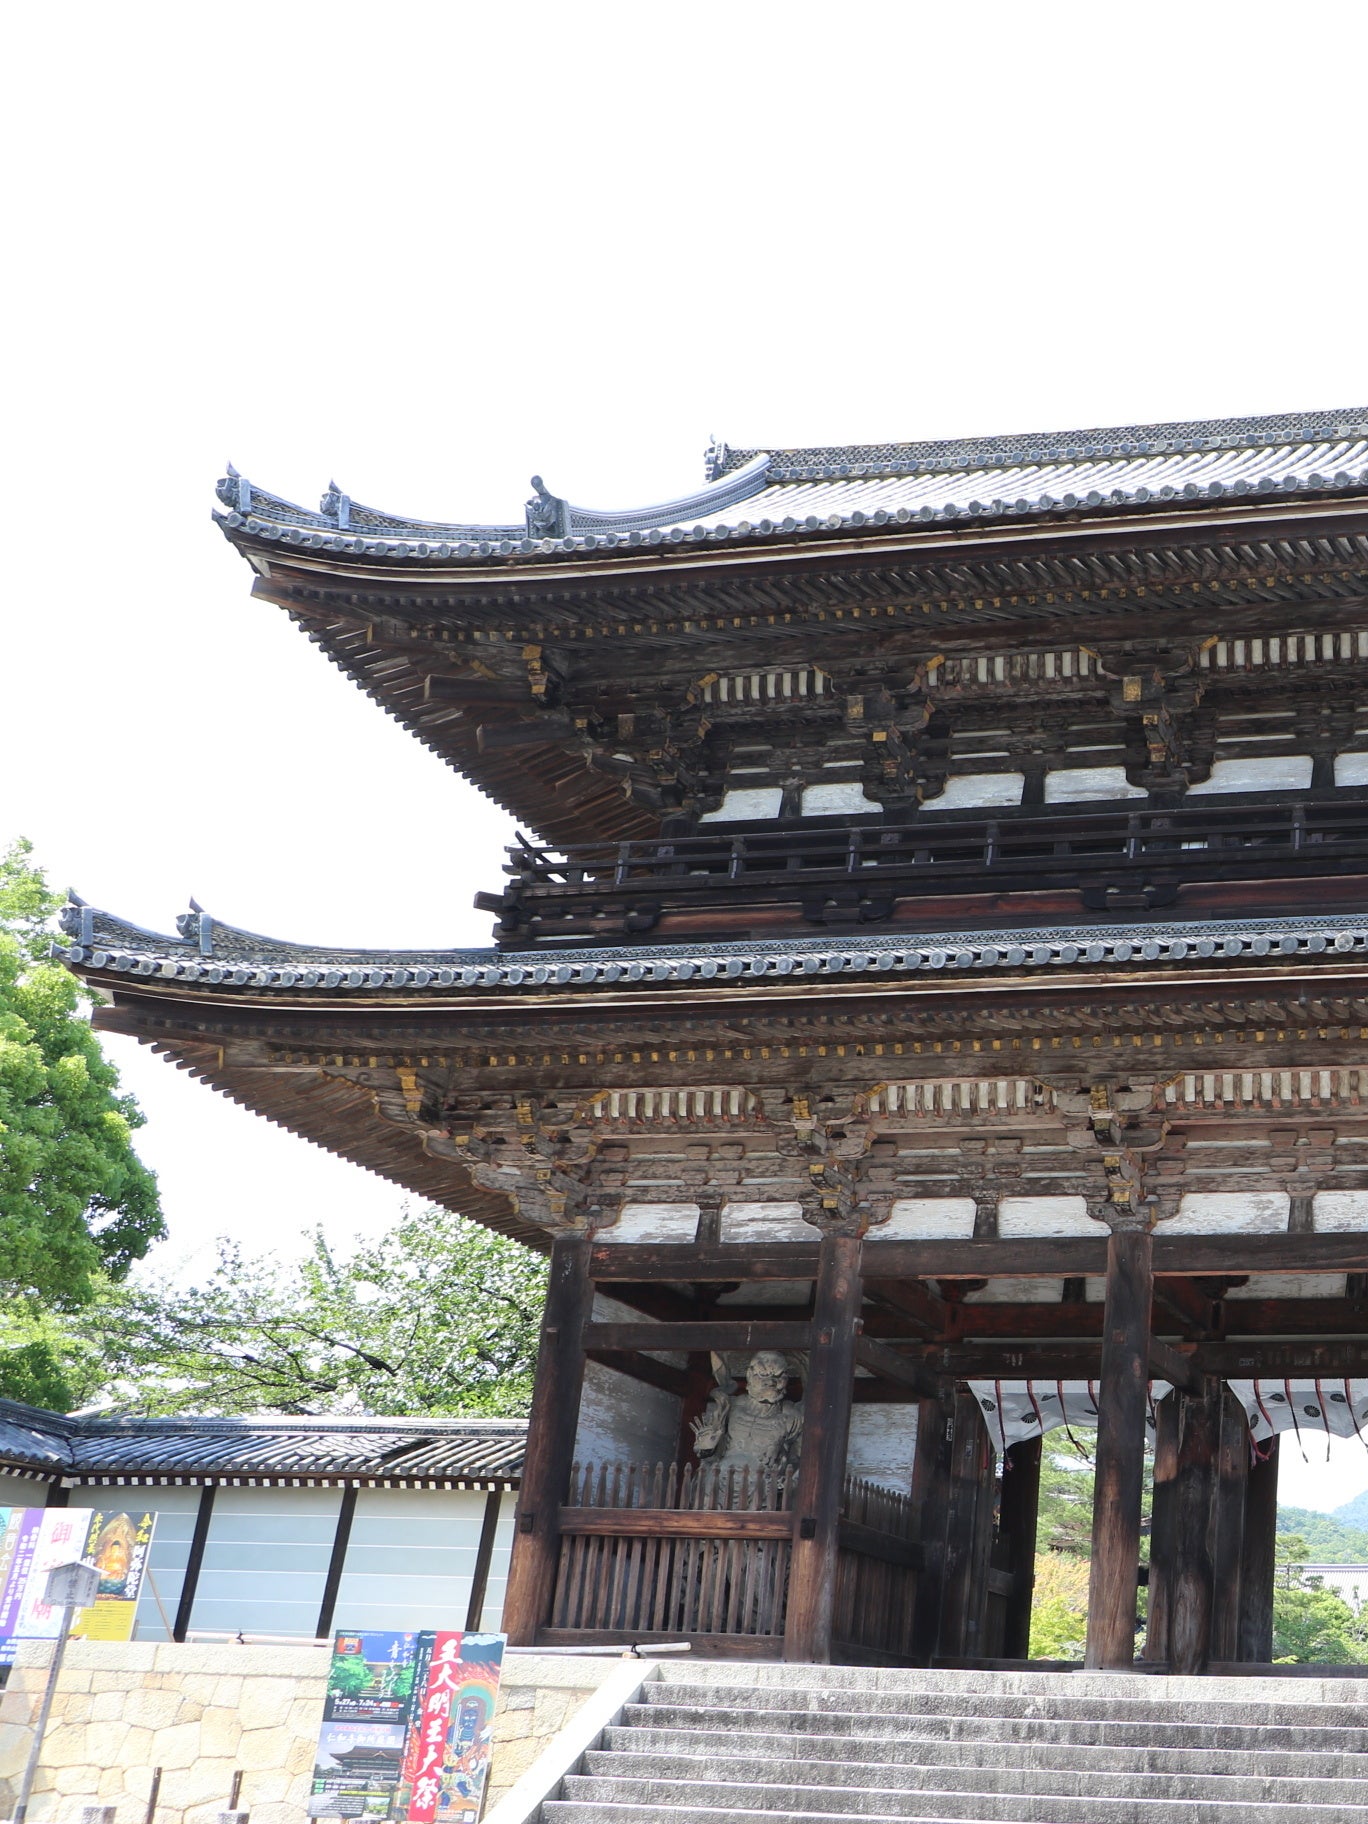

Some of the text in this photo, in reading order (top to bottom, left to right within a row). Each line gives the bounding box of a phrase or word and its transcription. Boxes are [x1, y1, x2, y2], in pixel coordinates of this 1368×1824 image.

[413, 1638, 464, 1810] 五大明王大祭
